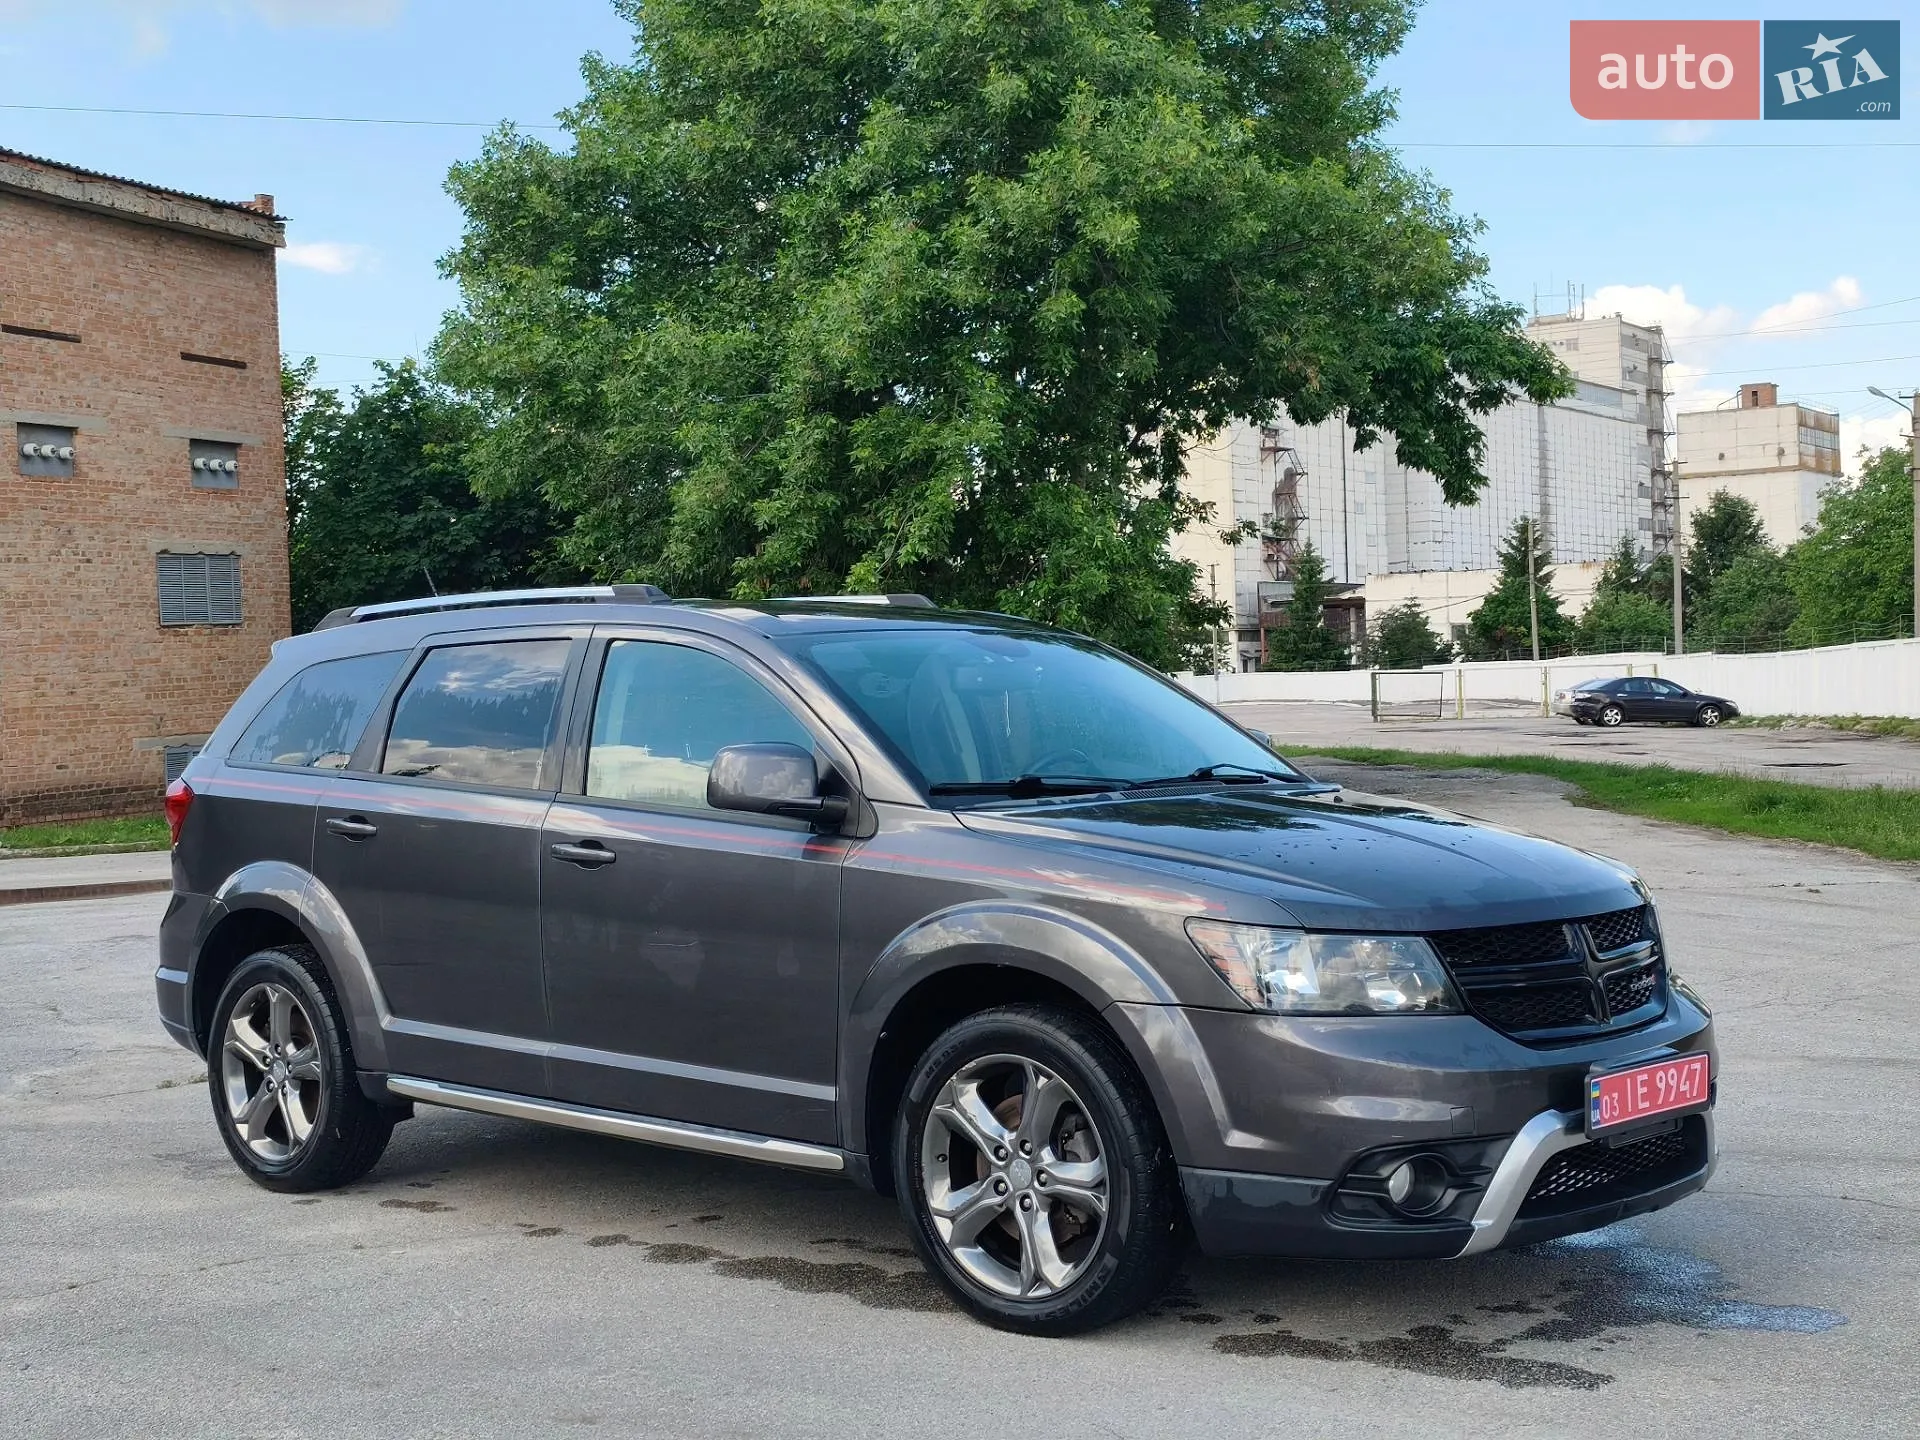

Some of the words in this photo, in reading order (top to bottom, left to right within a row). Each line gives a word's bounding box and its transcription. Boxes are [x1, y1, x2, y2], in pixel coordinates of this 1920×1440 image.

[1602, 1092, 1619, 1119] 03
[1627, 1073, 1650, 1113] IE
[1656, 1062, 1701, 1105] 9947
